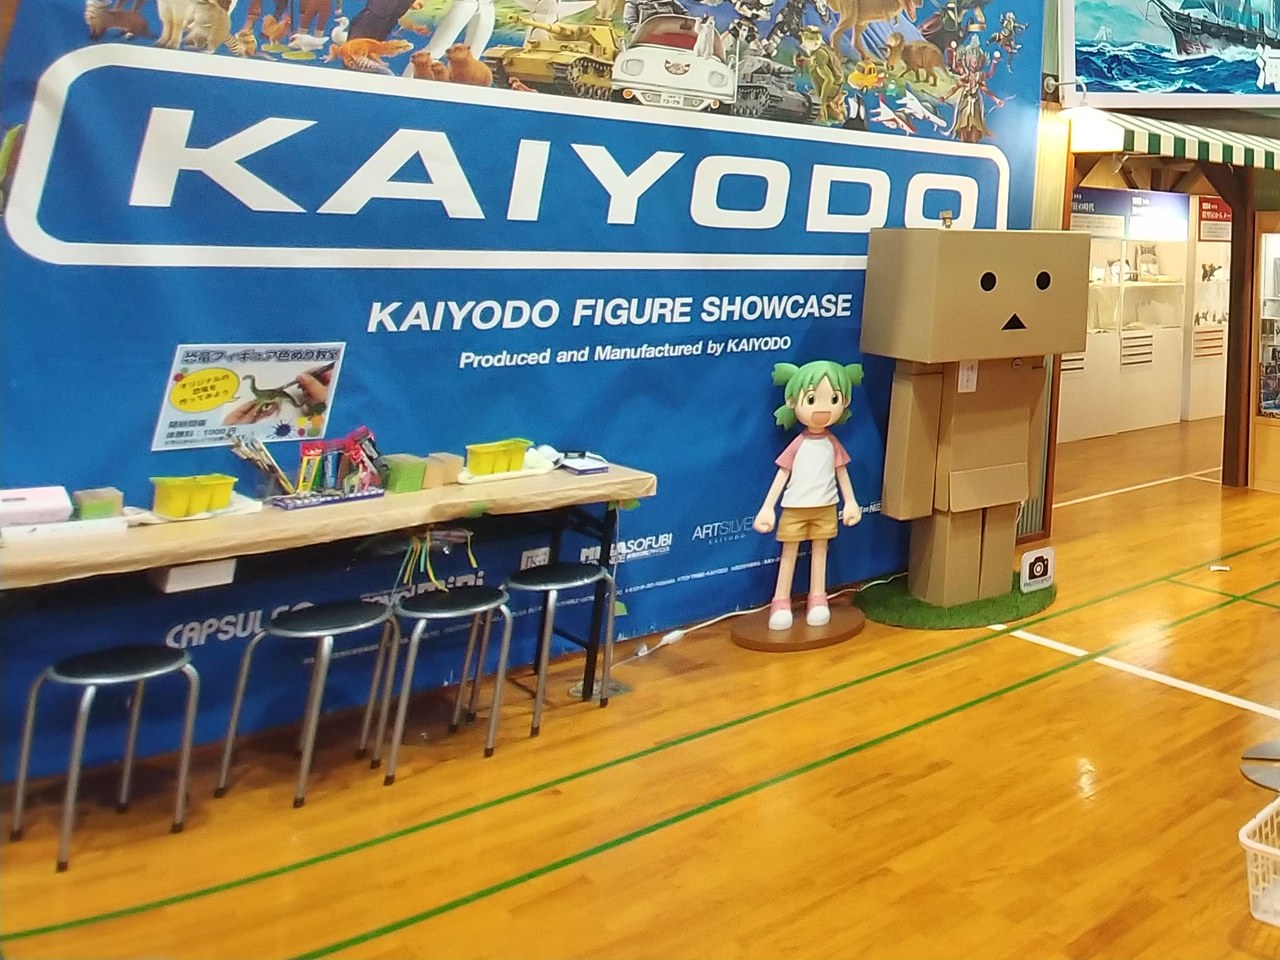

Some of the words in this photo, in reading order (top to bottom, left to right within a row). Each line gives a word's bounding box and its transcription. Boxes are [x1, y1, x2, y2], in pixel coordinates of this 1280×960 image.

[127, 108, 977, 234] KAIYODO
[367, 299, 560, 332] KAIYODO
[572, 297, 693, 326] FIGURE
[701, 294, 853, 322] SHOWCASE
[459, 348, 551, 368] Produced
[556, 346, 589, 363] and
[594, 340, 703, 361] Manufactured
[706, 340, 725, 356] by
[726, 335, 792, 353] KAIYODO
[692, 516, 757, 541] ARTSILVE
